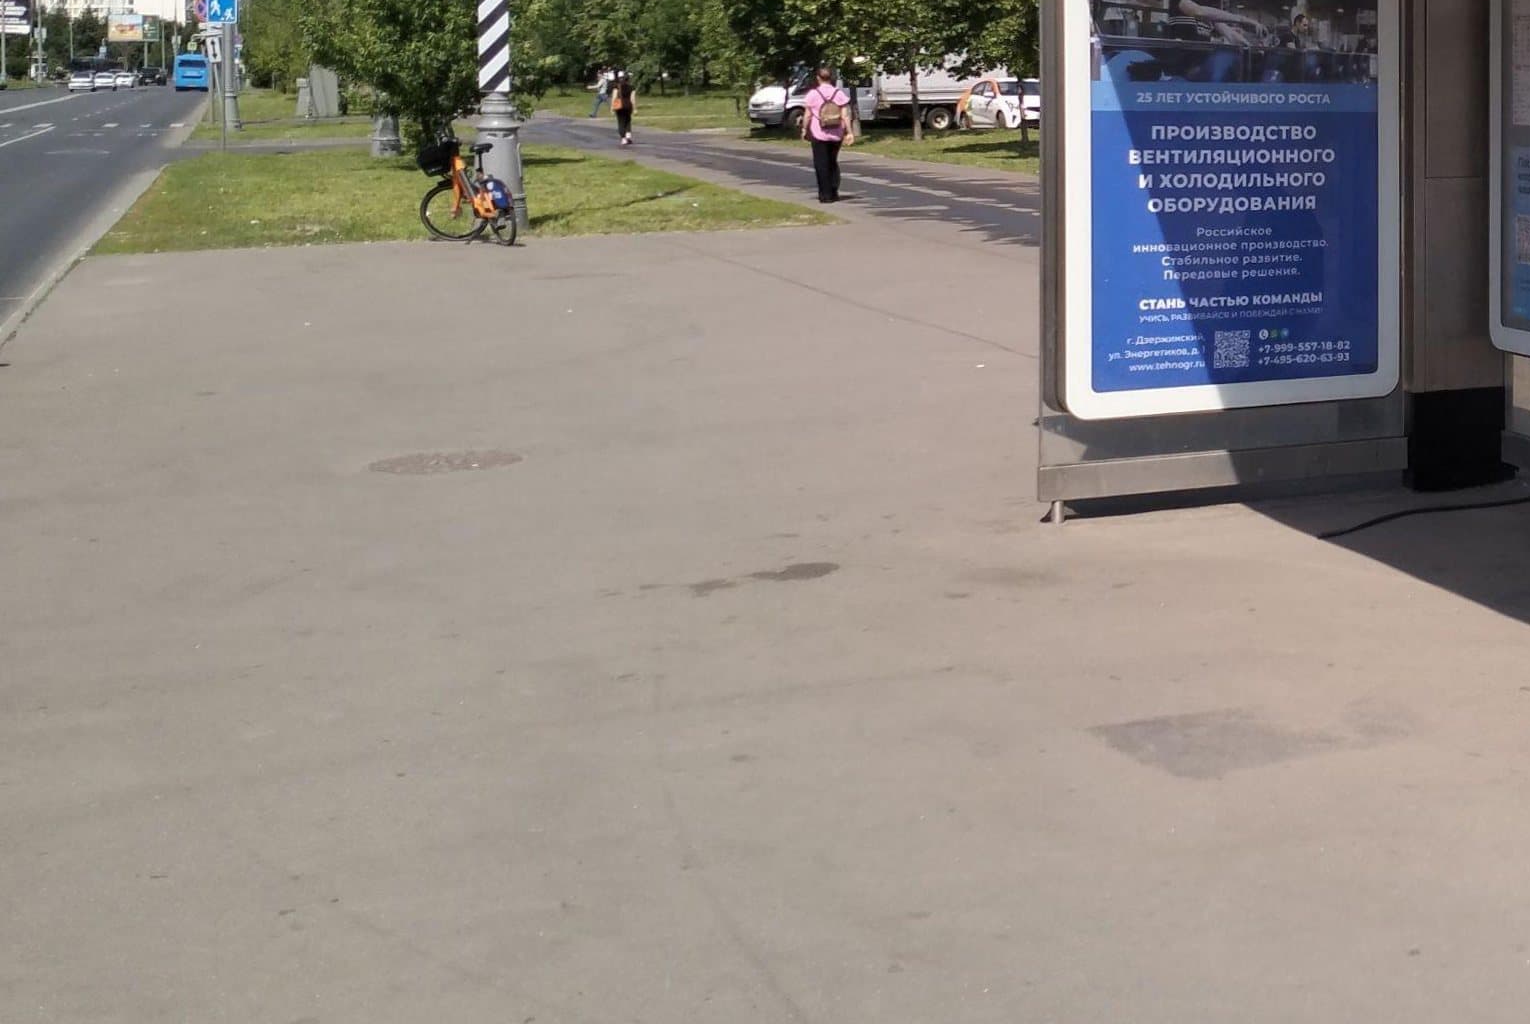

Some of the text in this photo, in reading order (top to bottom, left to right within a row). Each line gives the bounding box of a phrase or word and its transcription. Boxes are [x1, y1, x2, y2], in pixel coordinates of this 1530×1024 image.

[1136, 90, 1330, 104] 25 ЛЕТ УСТОЙЧИВОГО РОСТА
[1151, 125, 1317, 142] ПРОИЗВОДСТВО
[1128, 148, 1336, 166] ВЕНТИЛЯЦИОННОГО
[1138, 172, 1326, 190] И ХОЛОДИЛЬНОГО
[1147, 196, 1317, 213] ОБОРУДОВАНИЯ
[1196, 226, 1273, 237] Российское
[1133, 239, 1329, 253] инновационное производство.
[1161, 253, 1303, 267] Стабильное развитие.
[1163, 267, 1300, 281] Передовые решения.
[1139, 292, 1323, 310] СТАНЬ ЧАСТЬЮ КОМАНДЫ
[1139, 313, 1170, 324] УЧИСЬ,
[1129, 360, 1206, 372] www.tehnogr.ru
